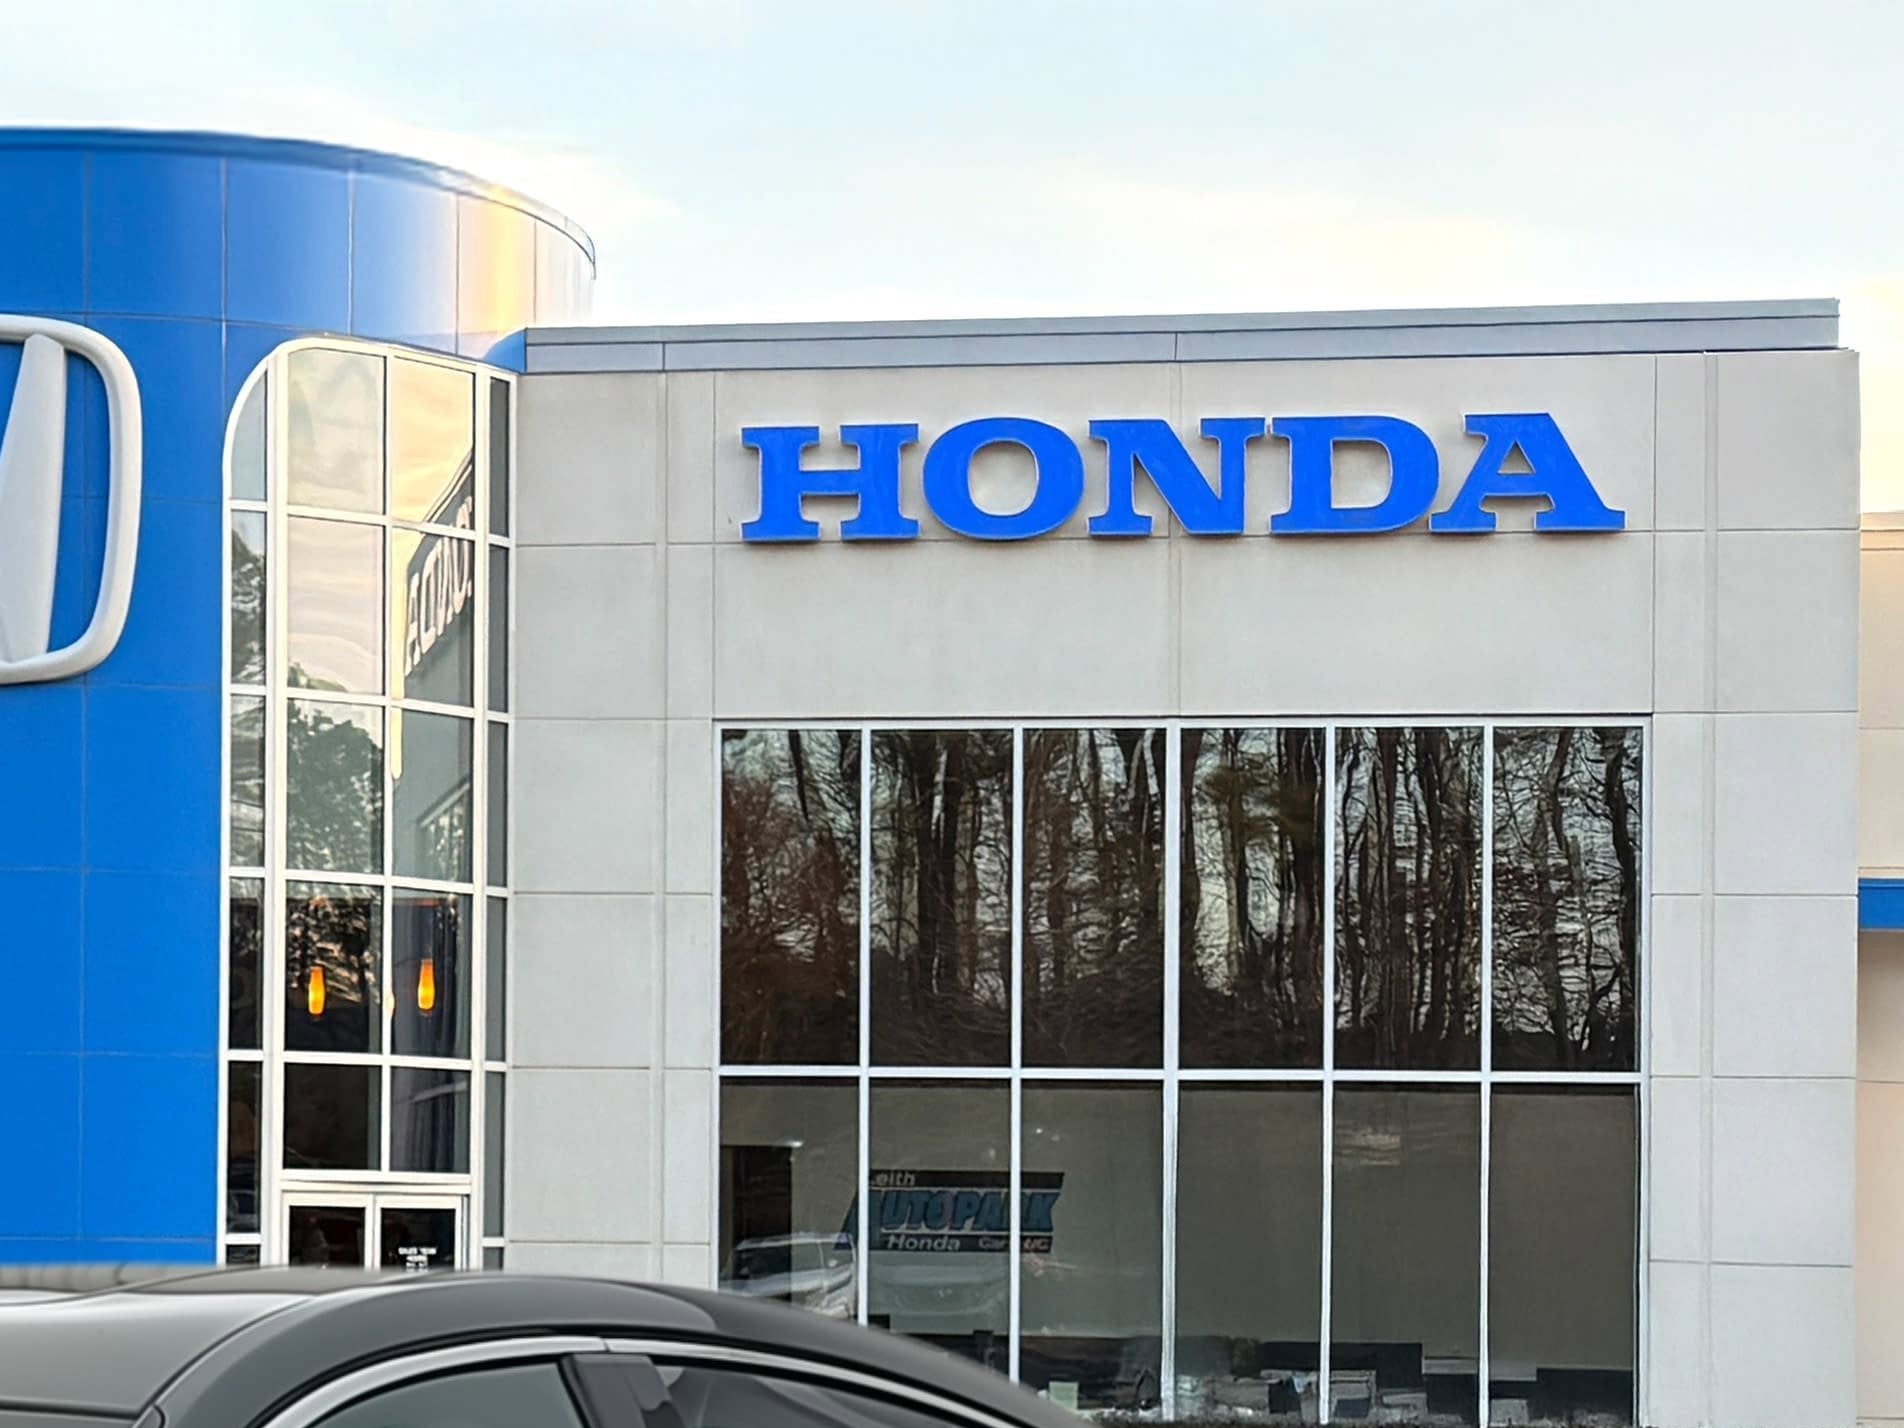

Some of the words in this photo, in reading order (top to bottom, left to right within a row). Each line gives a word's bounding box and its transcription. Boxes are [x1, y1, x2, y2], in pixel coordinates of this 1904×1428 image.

[741, 412, 1626, 543] HONDA
[870, 1171, 916, 1187] eith
[888, 1234, 961, 1251] Honda
